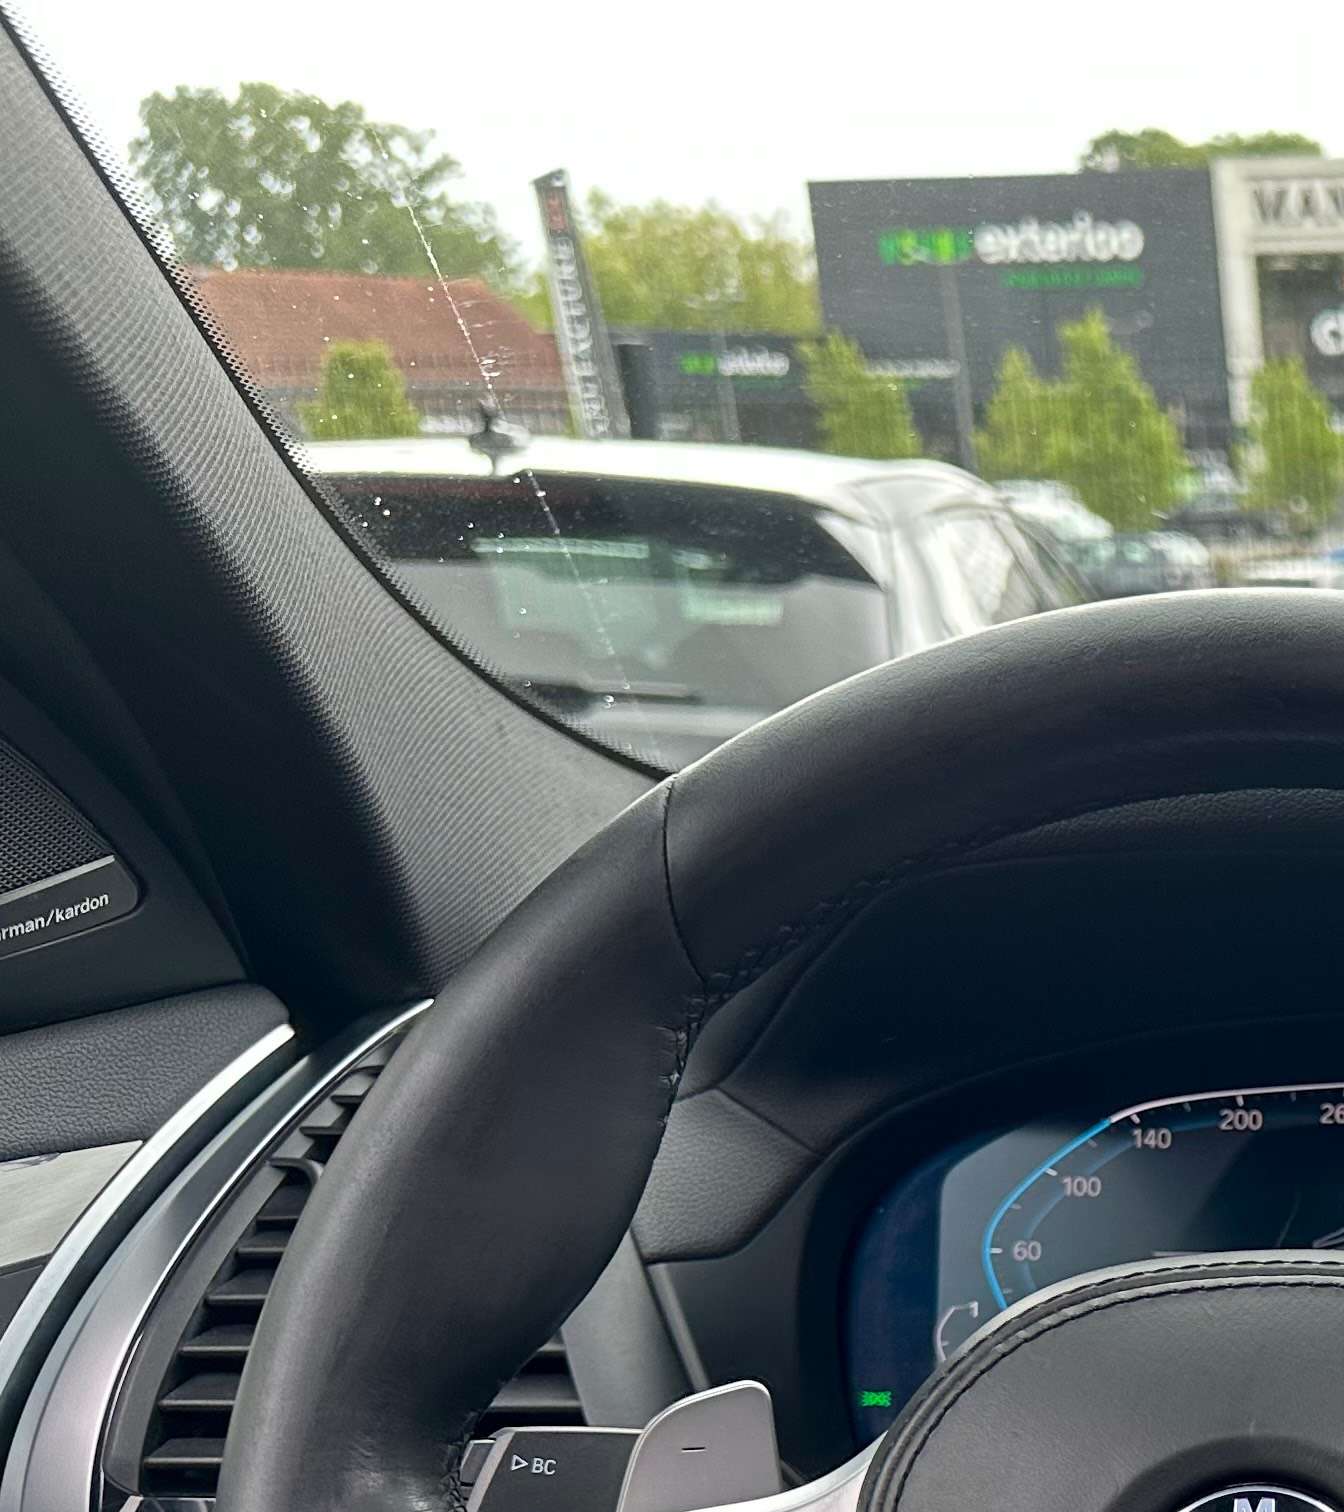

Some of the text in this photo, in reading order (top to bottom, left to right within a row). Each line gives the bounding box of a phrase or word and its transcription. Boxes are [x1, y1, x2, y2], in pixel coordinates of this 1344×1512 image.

[0, 894, 109, 940] rman/kardon
[1218, 1108, 1263, 1132] 200
[1133, 1128, 1172, 1150] 140
[1061, 1175, 1101, 1198] 100
[1012, 1240, 1042, 1262] 60
[532, 1457, 557, 1476] BC
